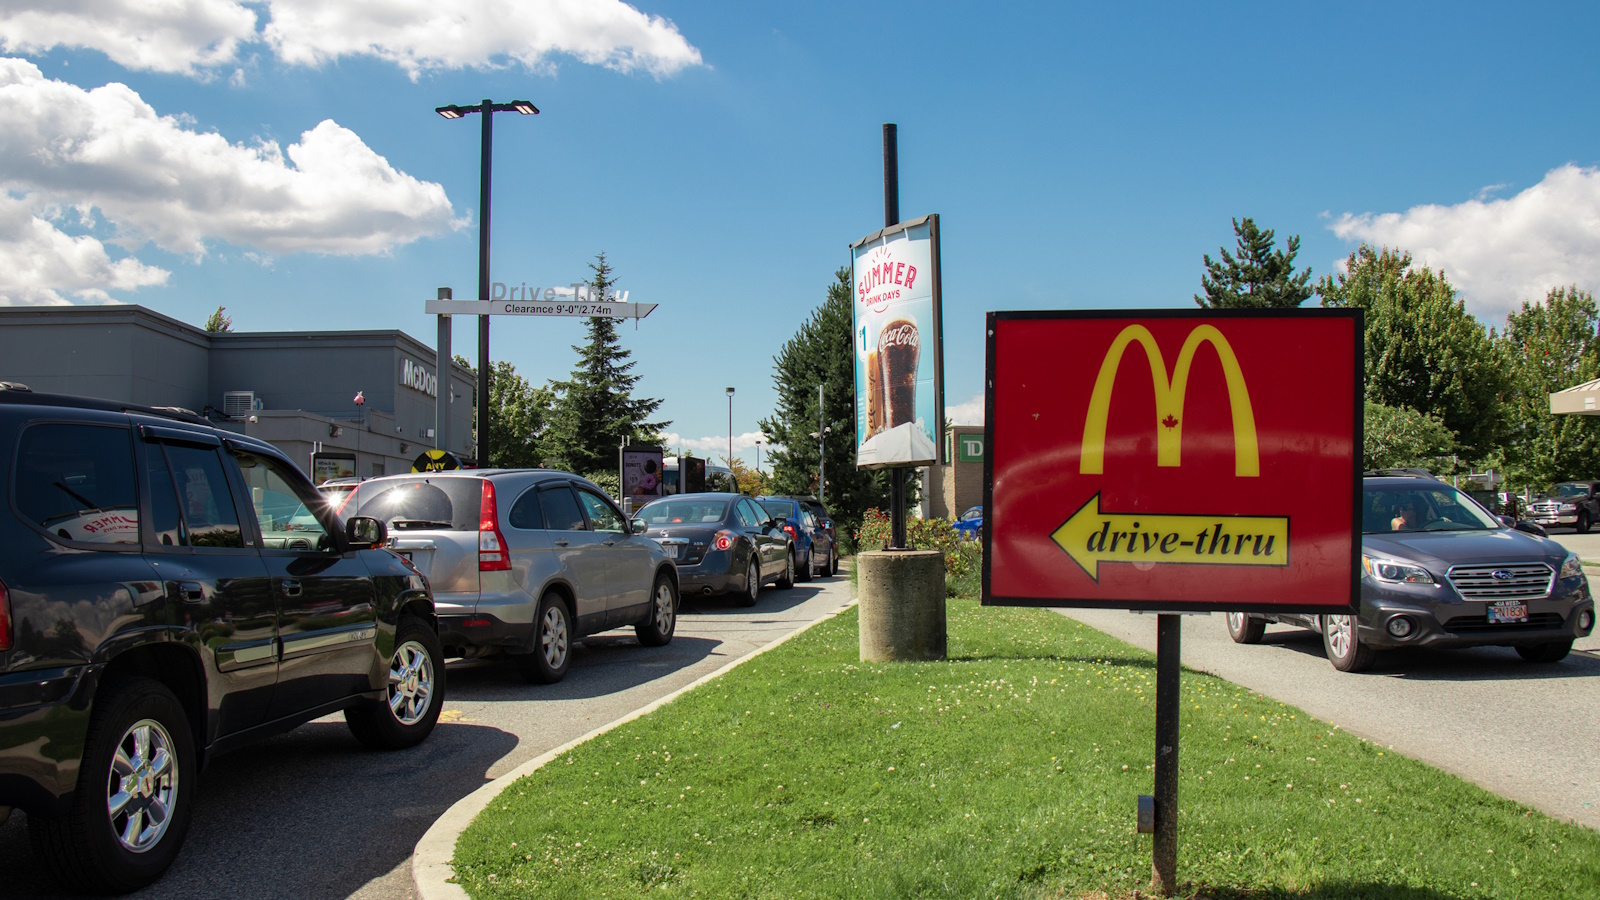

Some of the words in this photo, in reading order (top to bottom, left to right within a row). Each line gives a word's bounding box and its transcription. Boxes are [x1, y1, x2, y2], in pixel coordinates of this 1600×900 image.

[858, 261, 917, 302] SUMMER
[491, 282, 629, 302] Drive-Thru
[866, 294, 882, 307] DRINK
[882, 289, 901, 302] DAYS
[504, 304, 554, 314] Clearance
[963, 440, 984, 457] TD
[426, 462, 445, 470] ANY
[1086, 521, 1276, 556] drive-thru
